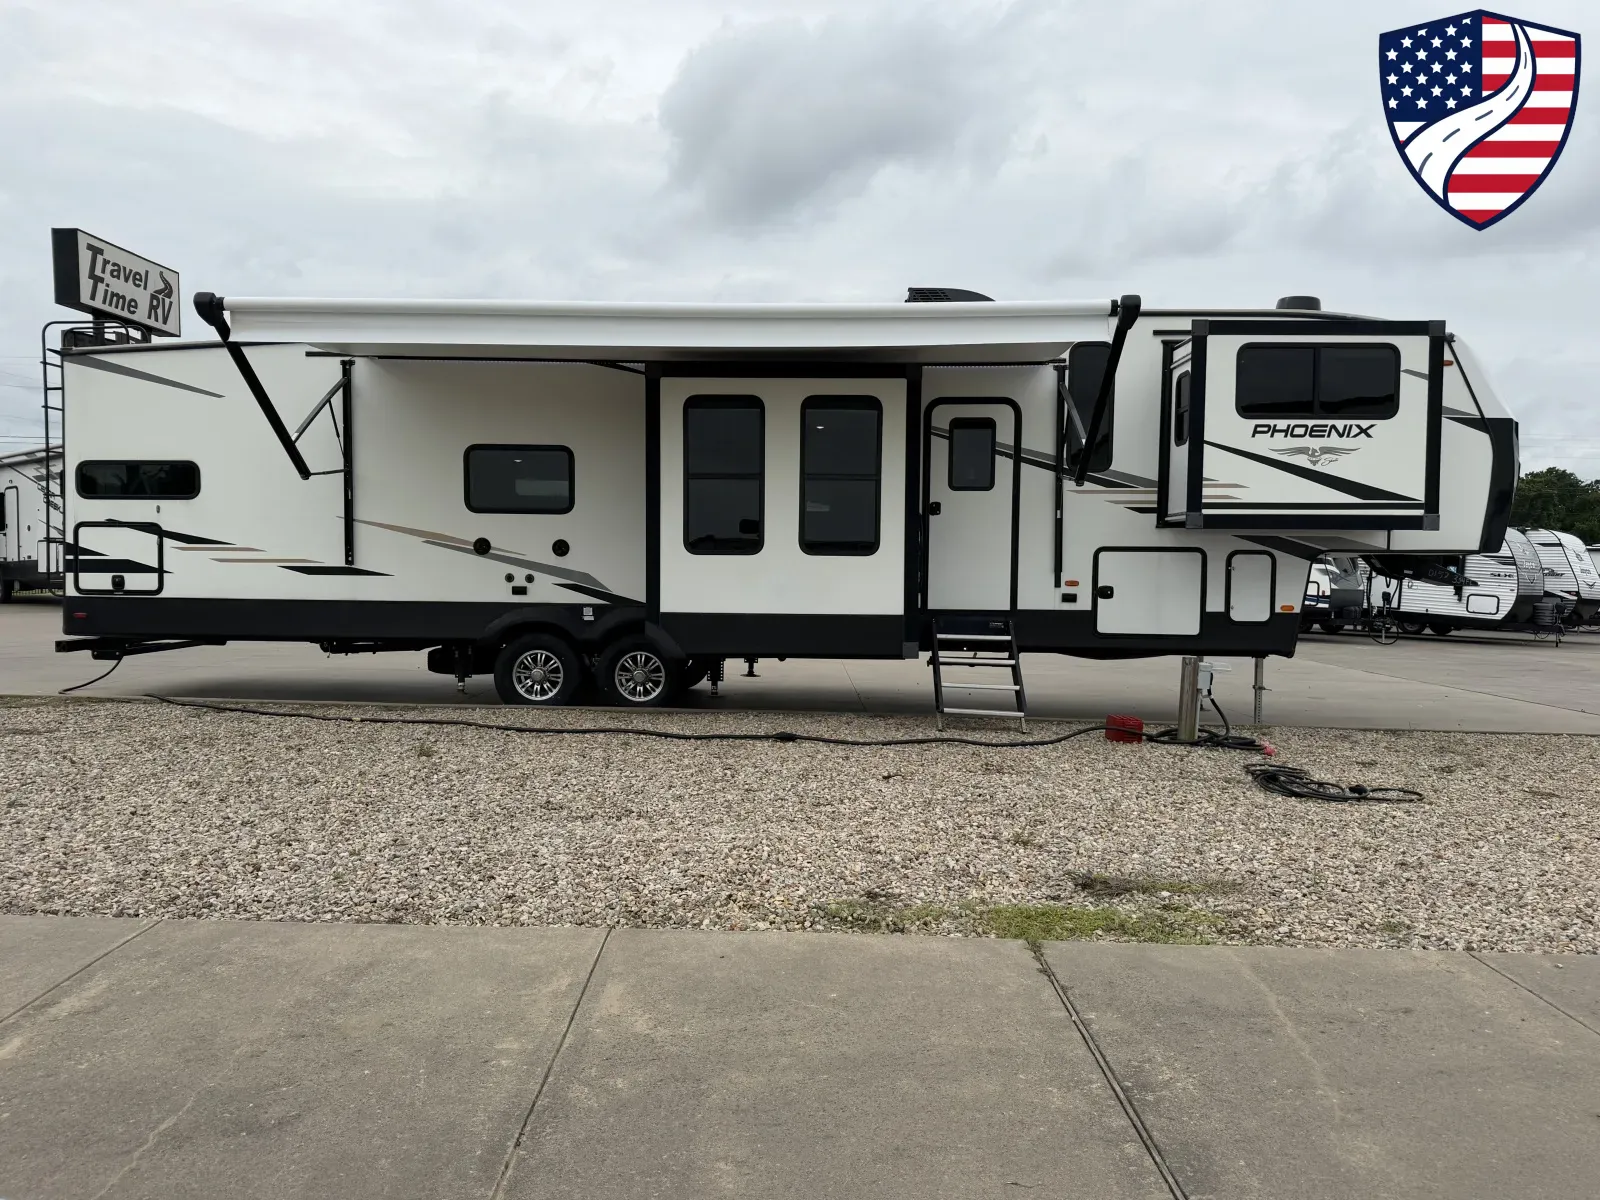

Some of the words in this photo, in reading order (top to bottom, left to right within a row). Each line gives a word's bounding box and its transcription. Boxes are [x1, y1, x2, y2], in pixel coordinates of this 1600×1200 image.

[86, 242, 149, 291] Travel
[88, 274, 139, 315] Time
[147, 292, 173, 326] RV
[1251, 423, 1378, 439] PHOENIX
